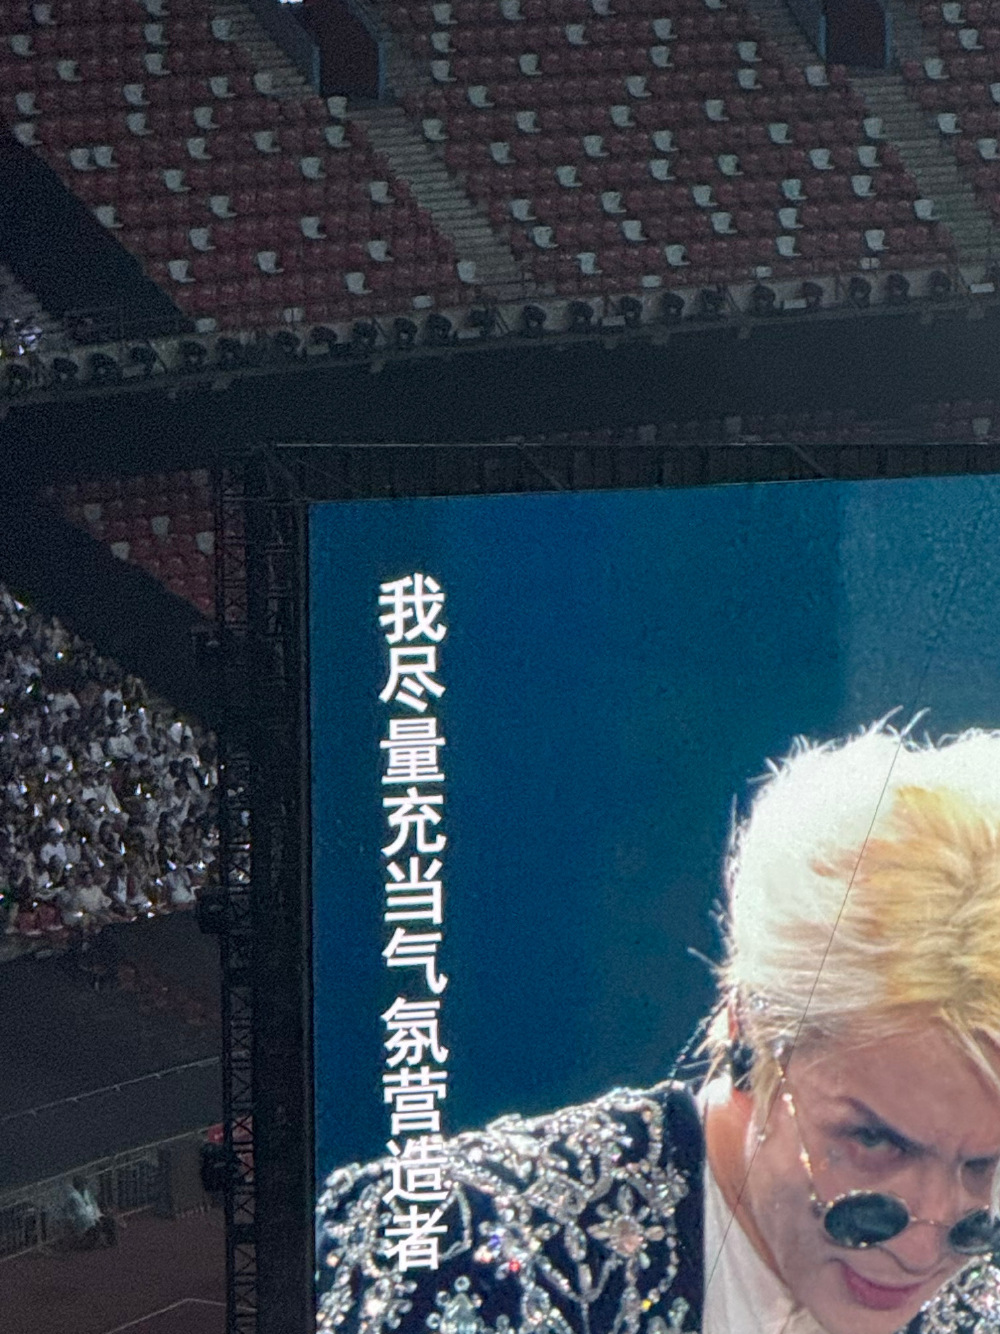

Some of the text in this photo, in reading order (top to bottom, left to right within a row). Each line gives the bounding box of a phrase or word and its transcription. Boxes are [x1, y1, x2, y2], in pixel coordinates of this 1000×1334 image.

[378, 572, 449, 1271] 我尽量充当气氛营造者
